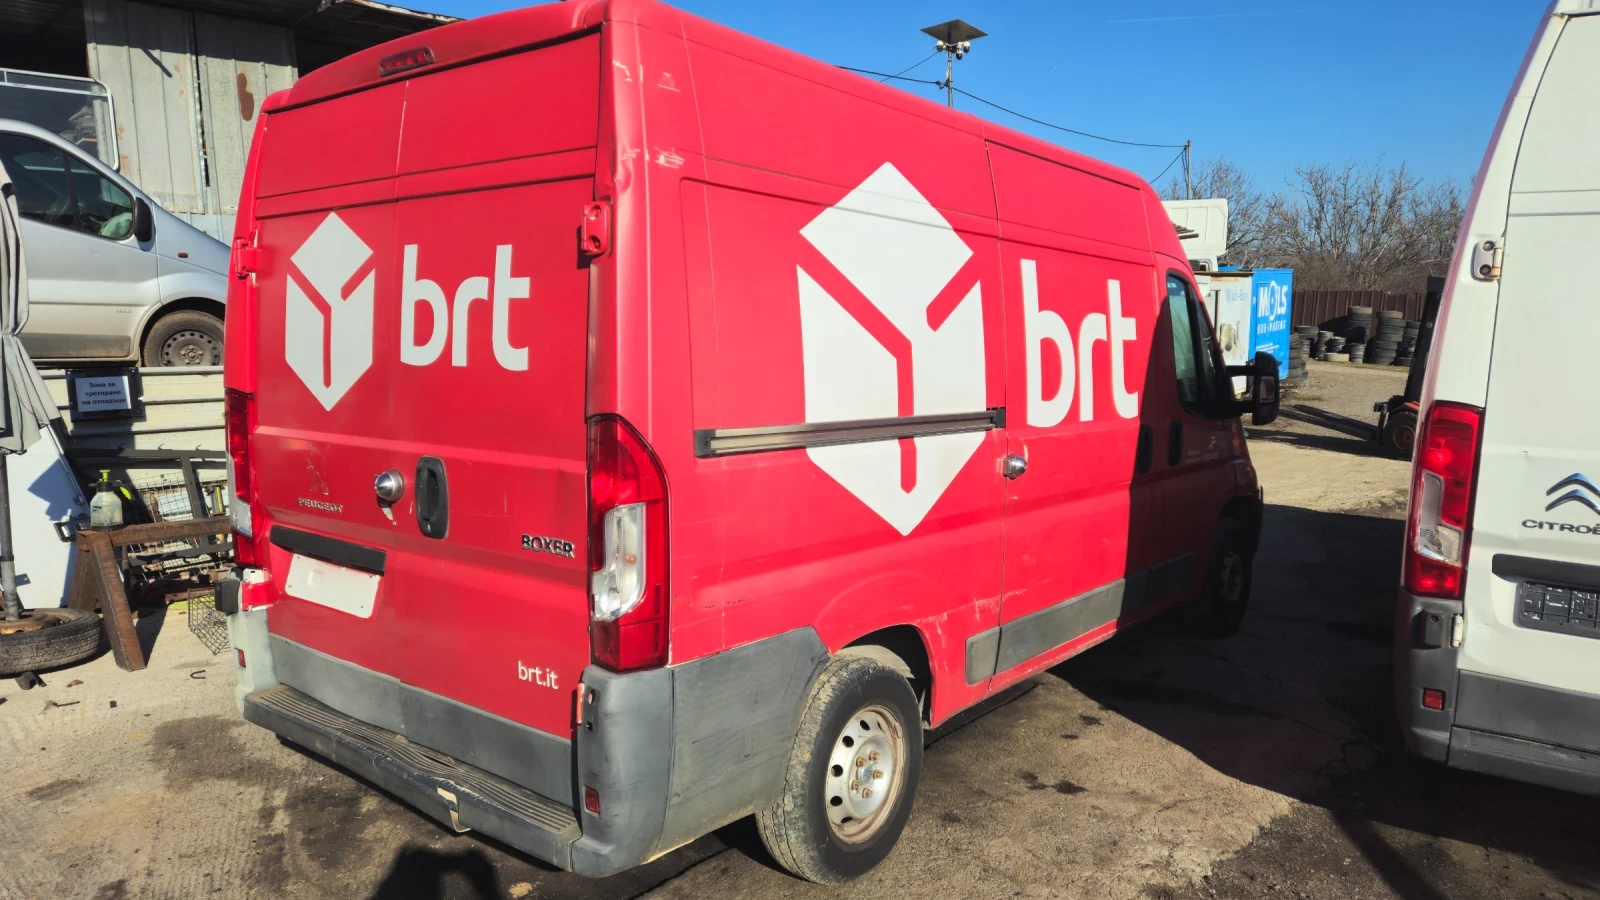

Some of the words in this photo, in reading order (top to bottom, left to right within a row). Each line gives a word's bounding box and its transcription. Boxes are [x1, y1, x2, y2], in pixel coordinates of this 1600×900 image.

[400, 244, 530, 371] brt
[1020, 258, 1138, 427] brt
[297, 497, 344, 513] PEUGEOT
[521, 533, 575, 558] BOXER
[517, 660, 559, 689] brt.it
